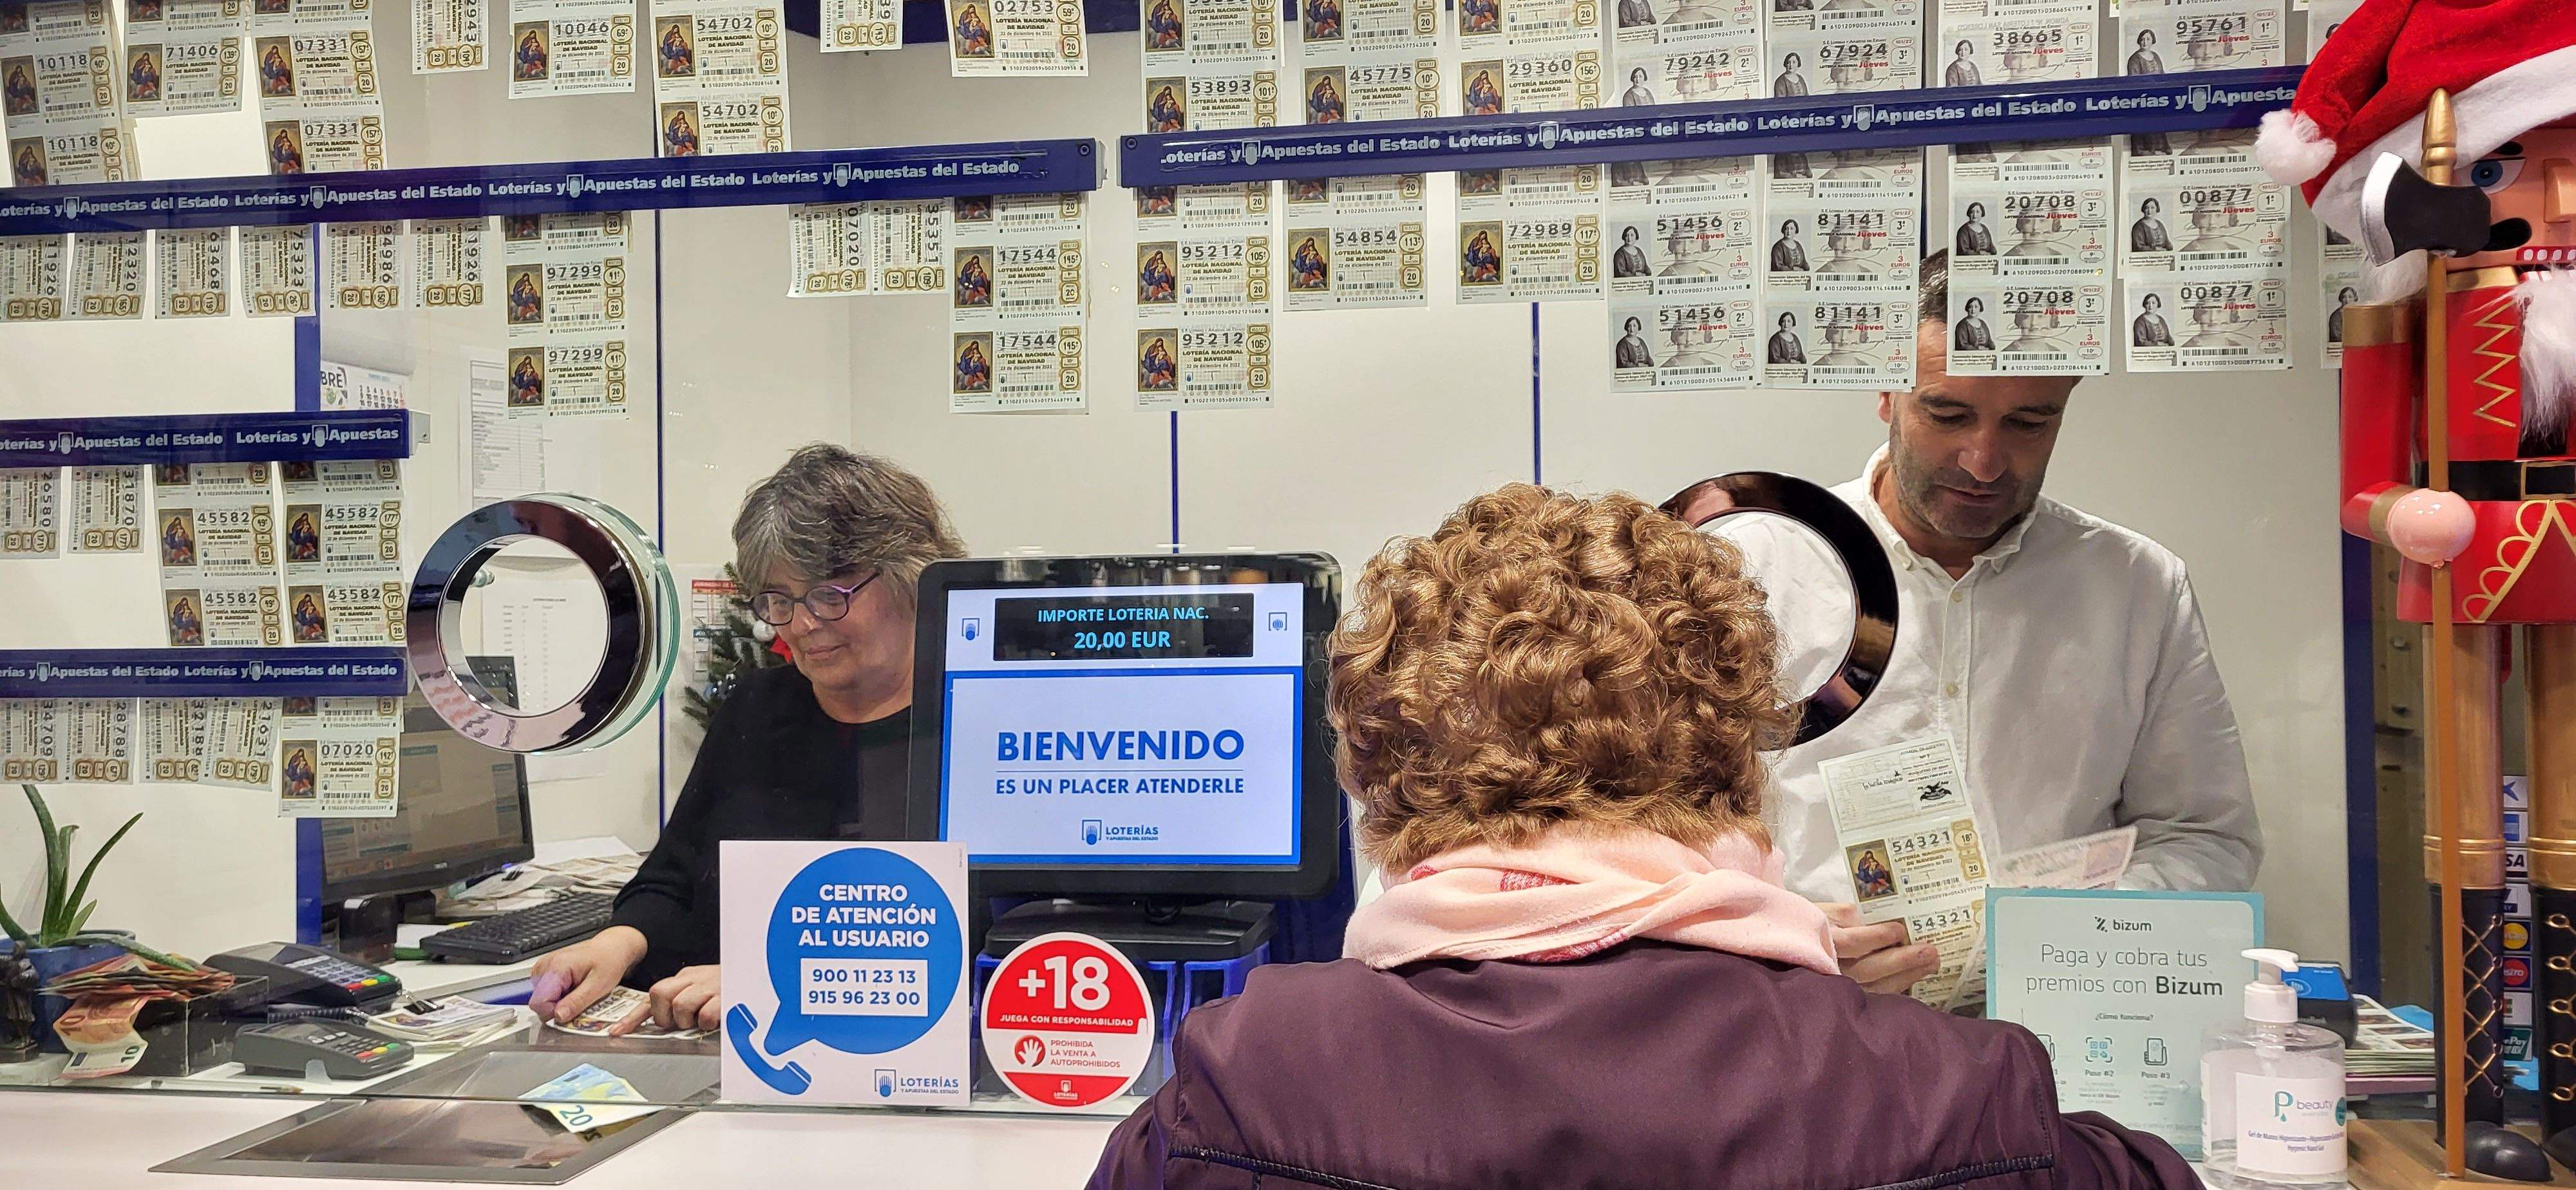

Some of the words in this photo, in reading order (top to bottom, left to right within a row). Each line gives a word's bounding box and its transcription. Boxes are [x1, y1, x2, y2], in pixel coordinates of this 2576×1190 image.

[553, 22, 609, 36] 10046
[696, 17, 753, 32] 54702
[2175, 17, 2249, 35] 95761
[294, 37, 349, 53] 07331
[1993, 30, 2062, 45] 38665
[166, 44, 218, 59] 71406
[1819, 44, 1888, 59] 67924
[37, 54, 88, 71] 10118
[1509, 59, 1573, 77] 29360
[1663, 53, 1731, 71] 79242
[1350, 66, 1412, 82] 45775
[1190, 80, 1251, 95] 53893
[1161, 149, 1226, 164] oterías
[1231, 150, 1241, 163] y
[1262, 142, 1341, 160] Apuestas
[1347, 140, 1374, 153] del
[1380, 137, 1440, 152] Estado
[1449, 133, 1522, 149] Loterías
[1528, 135, 1538, 147] y
[1559, 124, 1644, 142] Apuestas
[1651, 120, 1678, 135] del
[1685, 118, 1748, 135] Estado
[1757, 113, 1835, 130] Loterías
[1841, 115, 1853, 129] y
[1875, 105, 1964, 124] Apuestas
[1971, 101, 2002, 117] del
[2008, 98, 2076, 115] Estado
[2086, 93, 2169, 111] Loterías
[2175, 95, 2188, 109] y
[2211, 87, 2297, 107] Apuesta
[0, 203, 50, 216] oterías
[55, 205, 63, 217] y
[80, 199, 146, 214] Apuestas
[152, 198, 173, 209] del
[178, 195, 228, 208] Estado
[236, 192, 296, 205] Loterías
[301, 194, 308, 206] y
[327, 187, 397, 204] Apuestas
[402, 186, 424, 198] del
[430, 184, 482, 197] Estado
[489, 181, 552, 194] Loterías
[558, 184, 566, 197] y
[584, 177, 656, 192] Apuestas
[661, 175, 685, 187] del
[691, 173, 744, 186] Estado
[753, 169, 818, 184] Loterías
[823, 173, 832, 185] y
[852, 165, 926, 181] Apuestas
[933, 162, 957, 176] del
[963, 160, 1019, 175] Estado
[2005, 195, 2076, 211] 20708
[2180, 190, 2252, 205] 00877
[1656, 214, 1724, 232] 51456
[1817, 213, 1886, 227] 81141
[1334, 230, 1397, 245] 54854
[1509, 222, 1572, 238] 72989
[998, 247, 1056, 263] 17544
[1182, 244, 1244, 260] 95212
[546, 264, 602, 279] 97299
[320, 370, 343, 388] BRE
[49, 440, 57, 451] y
[74, 435, 141, 449] Apuestas
[146, 435, 167, 446] del
[173, 433, 222, 444] Estado
[237, 430, 297, 444] Loterías
[303, 433, 310, 444] y
[329, 428, 399, 442] Apuestas
[197, 511, 251, 525] 45582
[1037, 607, 1104, 623] IMPORTE
[1108, 607, 1170, 621] LOTERIA
[1173, 606, 1209, 620] NAC.
[1074, 631, 1125, 650] 20,00
[1131, 631, 1171, 648] EUR
[29, 669, 36, 679] y
[50, 666, 108, 679] Apuestas
[112, 666, 131, 676] del
[136, 666, 178, 676] Estado
[185, 665, 237, 676] Loterías
[242, 668, 249, 679] y
[264, 665, 323, 677] Apuestas
[328, 665, 348, 675] del
[353, 665, 397, 675] Estado
[321, 744, 374, 759] 07020
[998, 729, 1244, 761] BIENVENIDO
[996, 779, 1016, 795] ES
[1023, 779, 1052, 794] UN
[1059, 778, 1129, 794] PLACER
[1136, 777, 1244, 793] ATENDERLE
[1106, 824, 1159, 835] LOTERÍAS
[1891, 831, 1951, 853] 54321
[819, 884, 907, 902] CENTRO
[792, 907, 820, 924] DE
[826, 904, 936, 925] ATENCIÓN
[2113, 919, 2152, 932] bizum
[799, 929, 828, 947] AL
[831, 929, 930, 948] USUARIO
[2041, 943, 2088, 968] Paga
[2097, 950, 2108, 968] y
[2115, 946, 2169, 967] cobra
[2177, 948, 2207, 967] tus
[813, 968, 848, 983] 900
[853, 969, 867, 983] 11
[872, 970, 895, 984] 23
[898, 970, 916, 984] 13
[1019, 955, 1111, 1011] +18
[2026, 974, 2105, 996] premios
[2112, 978, 2147, 994] con
[2156, 976, 2223, 996] Bizum
[809, 991, 837, 1005] 915
[842, 991, 865, 1005] 96
[870, 992, 891, 1006] 23
[896, 992, 920, 1006] 00
[999, 1014, 1028, 1023] JUEGA
[1030, 1015, 1050, 1023] CON
[1052, 1016, 1133, 1026] RESPONSABILIDAD
[1050, 1039, 1094, 1048] PROHIBIDA
[121, 1046, 140, 1062] 10
[1050, 1059, 1121, 1068] AUTOPROHIBIDOS
[901, 1076, 959, 1088] LOTERÍAS
[2297, 1100, 2333, 1110] beauty
[559, 1104, 592, 1126] 20
